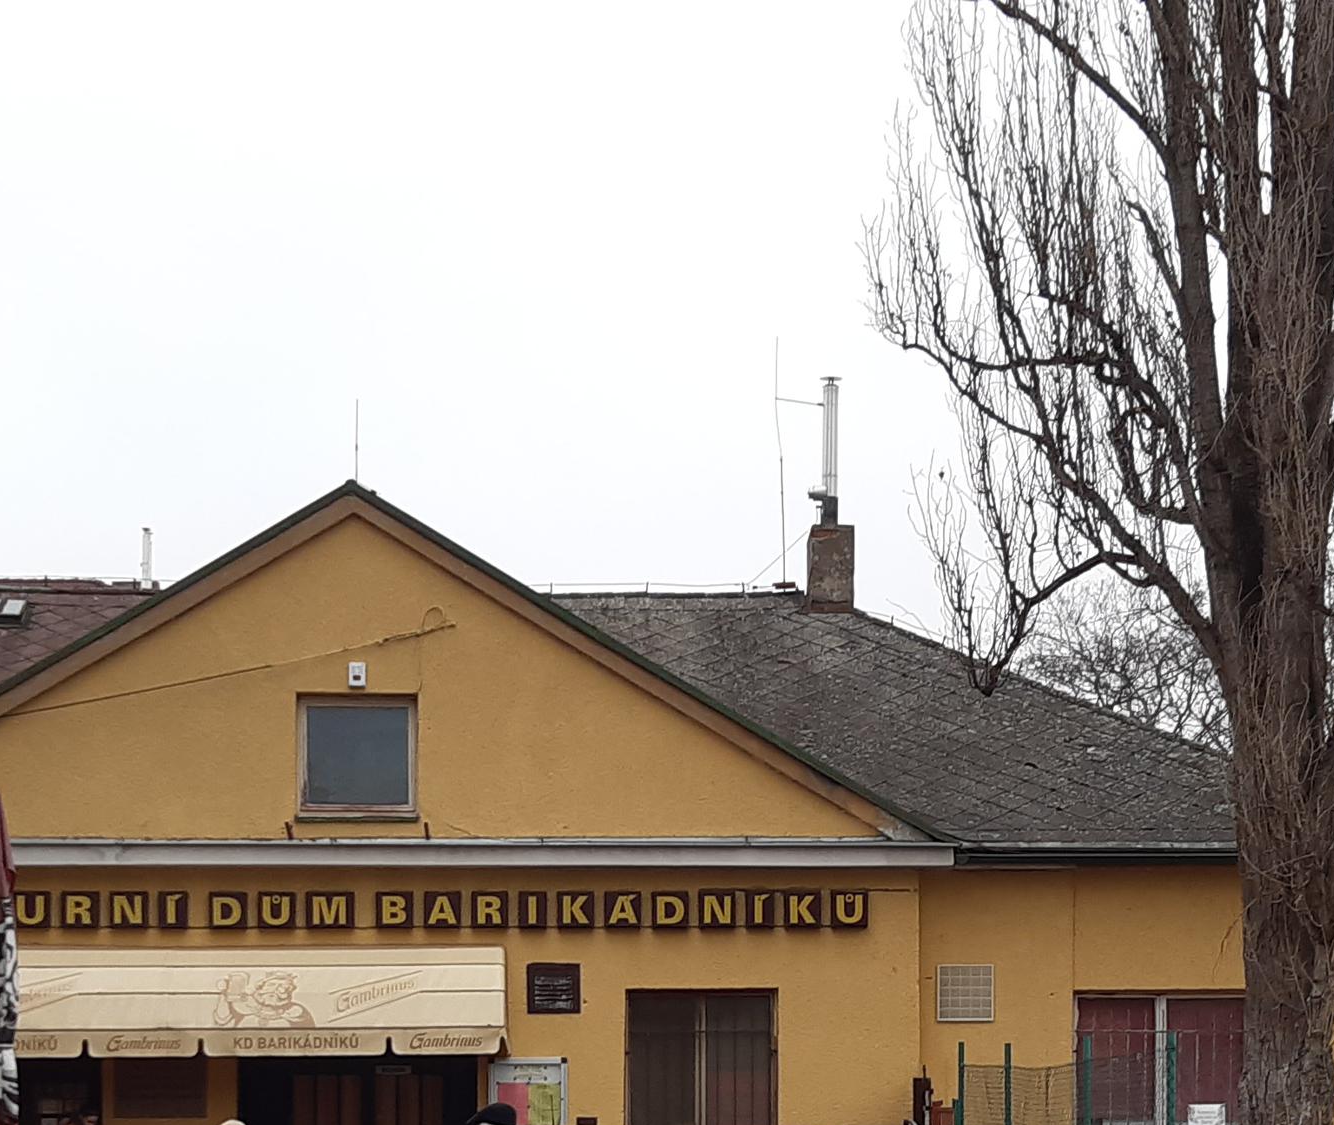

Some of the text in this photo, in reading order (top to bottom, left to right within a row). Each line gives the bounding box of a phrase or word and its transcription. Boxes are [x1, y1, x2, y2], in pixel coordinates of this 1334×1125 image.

[212, 893, 347, 925] DŮM
[381, 891, 865, 925] BARIKÁDNÍKŮ
[336, 978, 416, 1013] Gambrinus
[106, 1034, 182, 1052] Gambrinus
[233, 1033, 360, 1050] KD BARIKÁDNÍKŮ
[409, 1032, 483, 1050] Gambrinus
